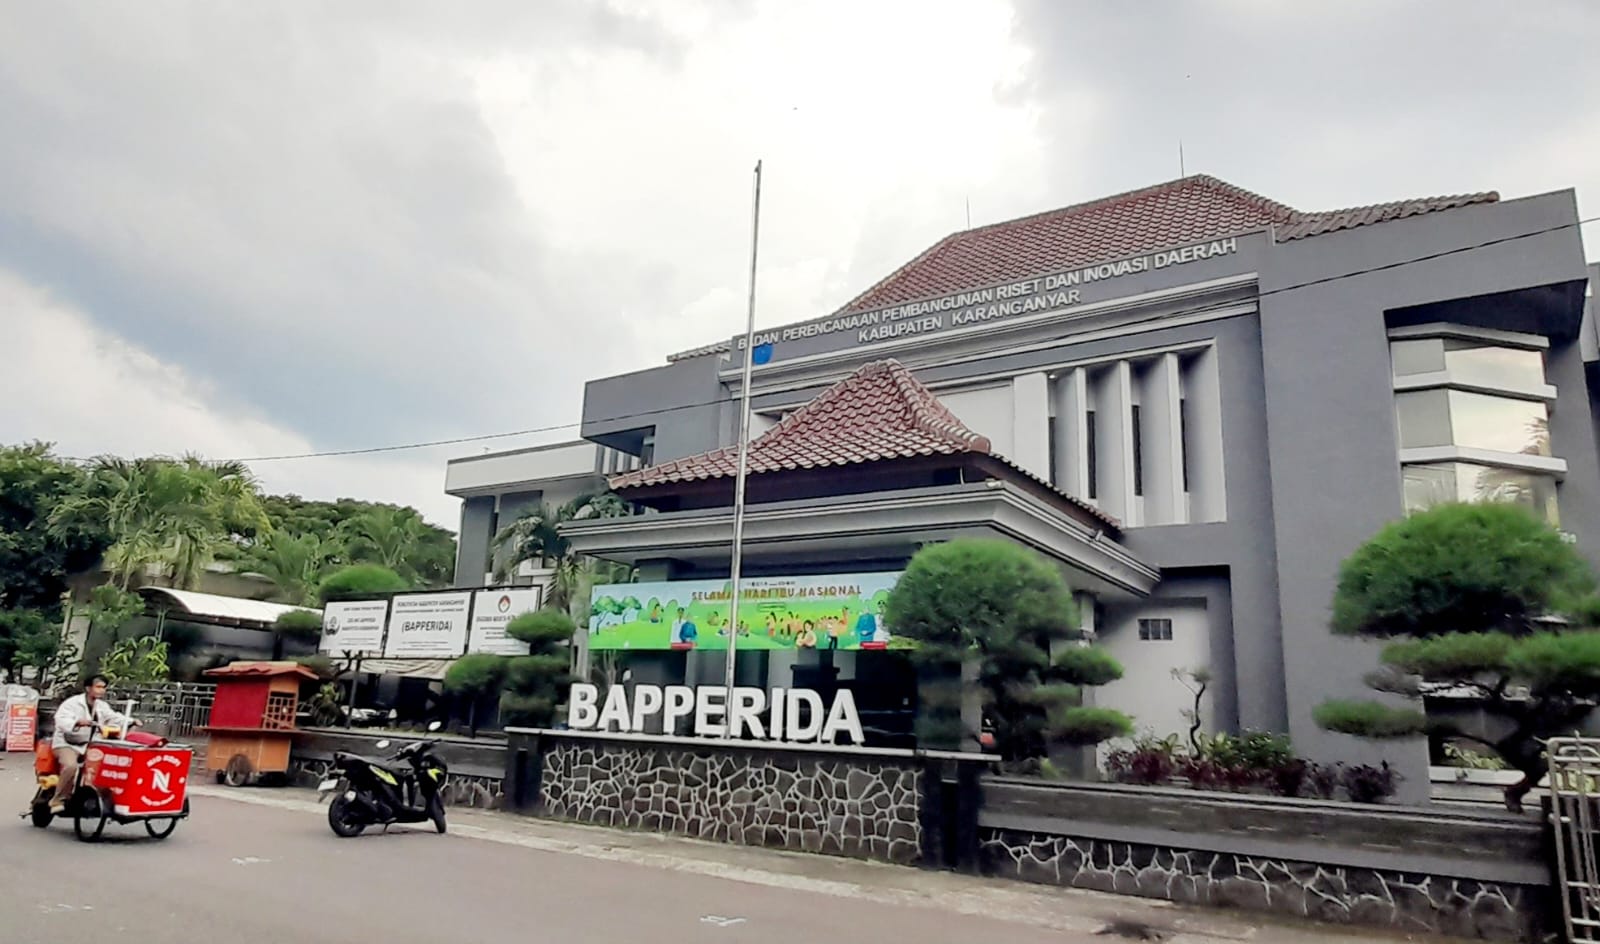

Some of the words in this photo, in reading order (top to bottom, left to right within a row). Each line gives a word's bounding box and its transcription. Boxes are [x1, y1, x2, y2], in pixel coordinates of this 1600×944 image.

[738, 331, 778, 350] BDAN
[783, 312, 879, 341] PERENCANAAN
[881, 288, 992, 322] PEMBANGUNAN
[996, 279, 1040, 300] RISET
[1045, 270, 1080, 290] DAN
[1084, 258, 1148, 282] INOVASI
[1154, 238, 1237, 269] DAERAH
[858, 316, 942, 342] KABUPATEN
[951, 289, 1080, 325] KARANGANYAR
[799, 585, 862, 597] NASIONAL
[401, 621, 453, 632] (BAPPERIDA)
[568, 683, 865, 743] BAPPERIDA
